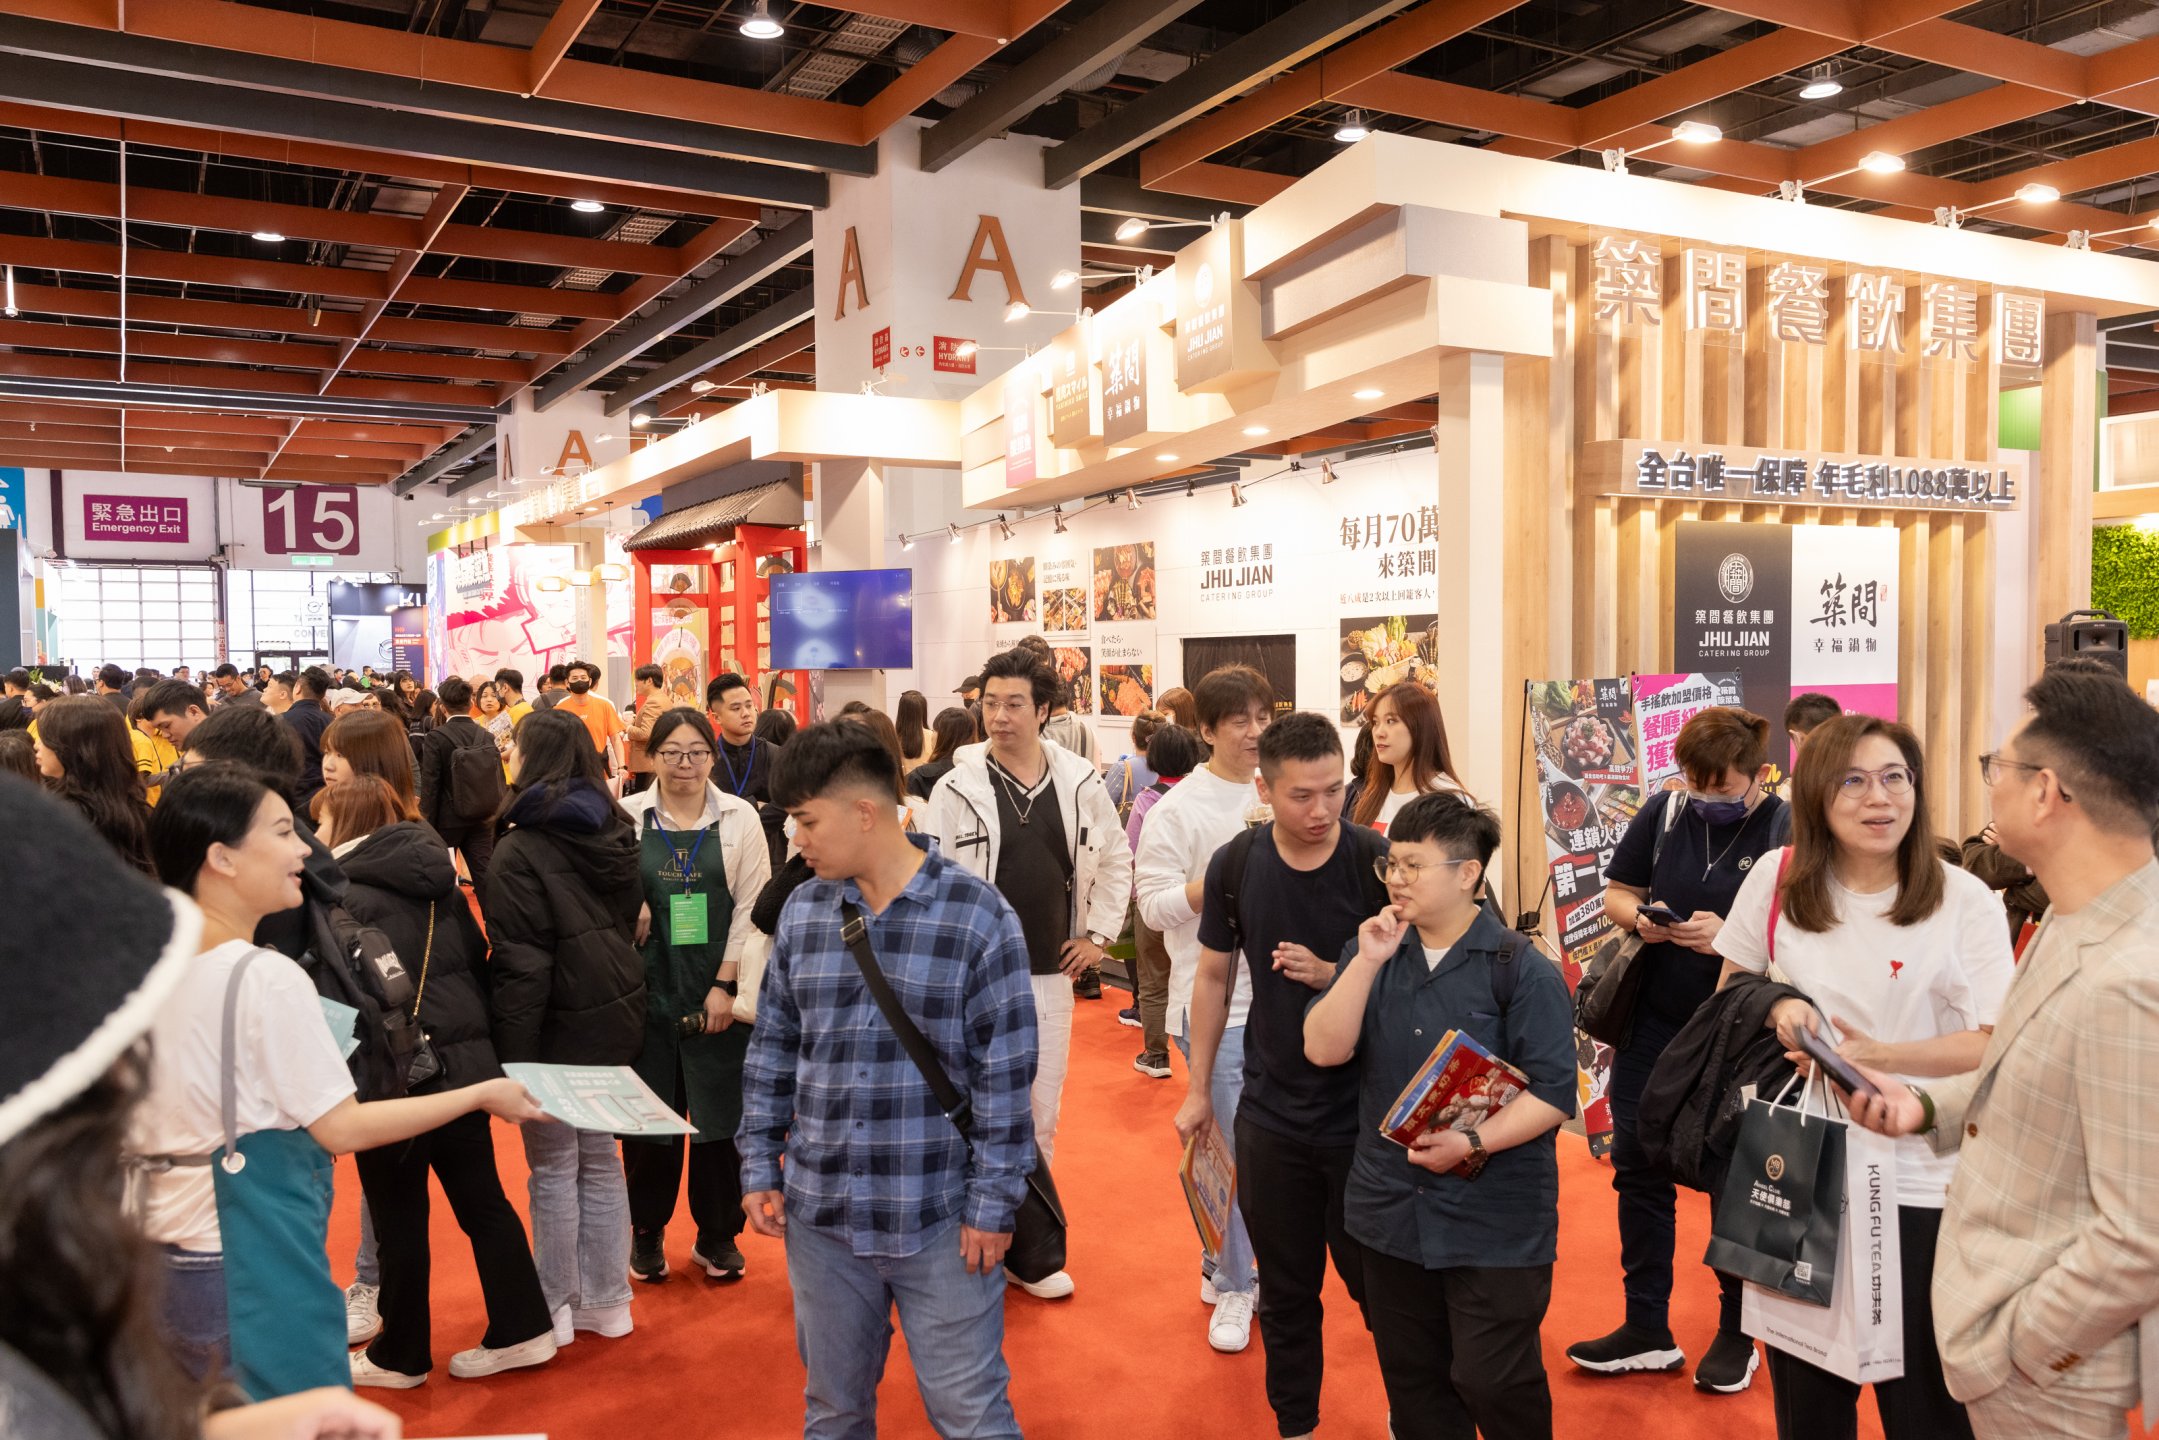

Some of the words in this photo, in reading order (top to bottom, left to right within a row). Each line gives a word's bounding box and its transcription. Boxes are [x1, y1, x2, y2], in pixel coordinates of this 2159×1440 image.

[834, 226, 870, 321] A
[948, 214, 1031, 307] A
[1593, 236, 2045, 367] 築間餐飲集團
[552, 430, 593, 475] A
[1636, 449, 1808, 496] 全台唯一保障
[1812, 458, 2016, 504] 年毛利1088萬以上
[92, 503, 181, 523] 緊急出口
[268, 489, 354, 551] 15
[92, 522, 156, 535] Emergency
[159, 524, 181, 534] Exit
[1339, 505, 1439, 551] 每月70萬
[1201, 543, 1273, 567] 築間餐飲集團
[1201, 568, 1232, 590] JHU
[1236, 564, 1273, 587] JIAN
[1200, 592, 1242, 602] CATERING
[1246, 589, 1273, 599] GROUP
[1809, 572, 1878, 628] 築間
[1695, 609, 1774, 625] 築間餐飲集團
[1699, 631, 1732, 647] JHU
[1734, 631, 1770, 647] JIAN
[1813, 637, 1877, 653] 幸福鍋物
[1699, 649, 1741, 657] CATERING
[1744, 649, 1770, 657] GROUP
[1641, 686, 1712, 711] 手搖飲加盟價格
[1868, 1164, 1881, 1212] KUNG
[1870, 1215, 1881, 1238] FU
[1871, 1240, 1881, 1273] TEA
